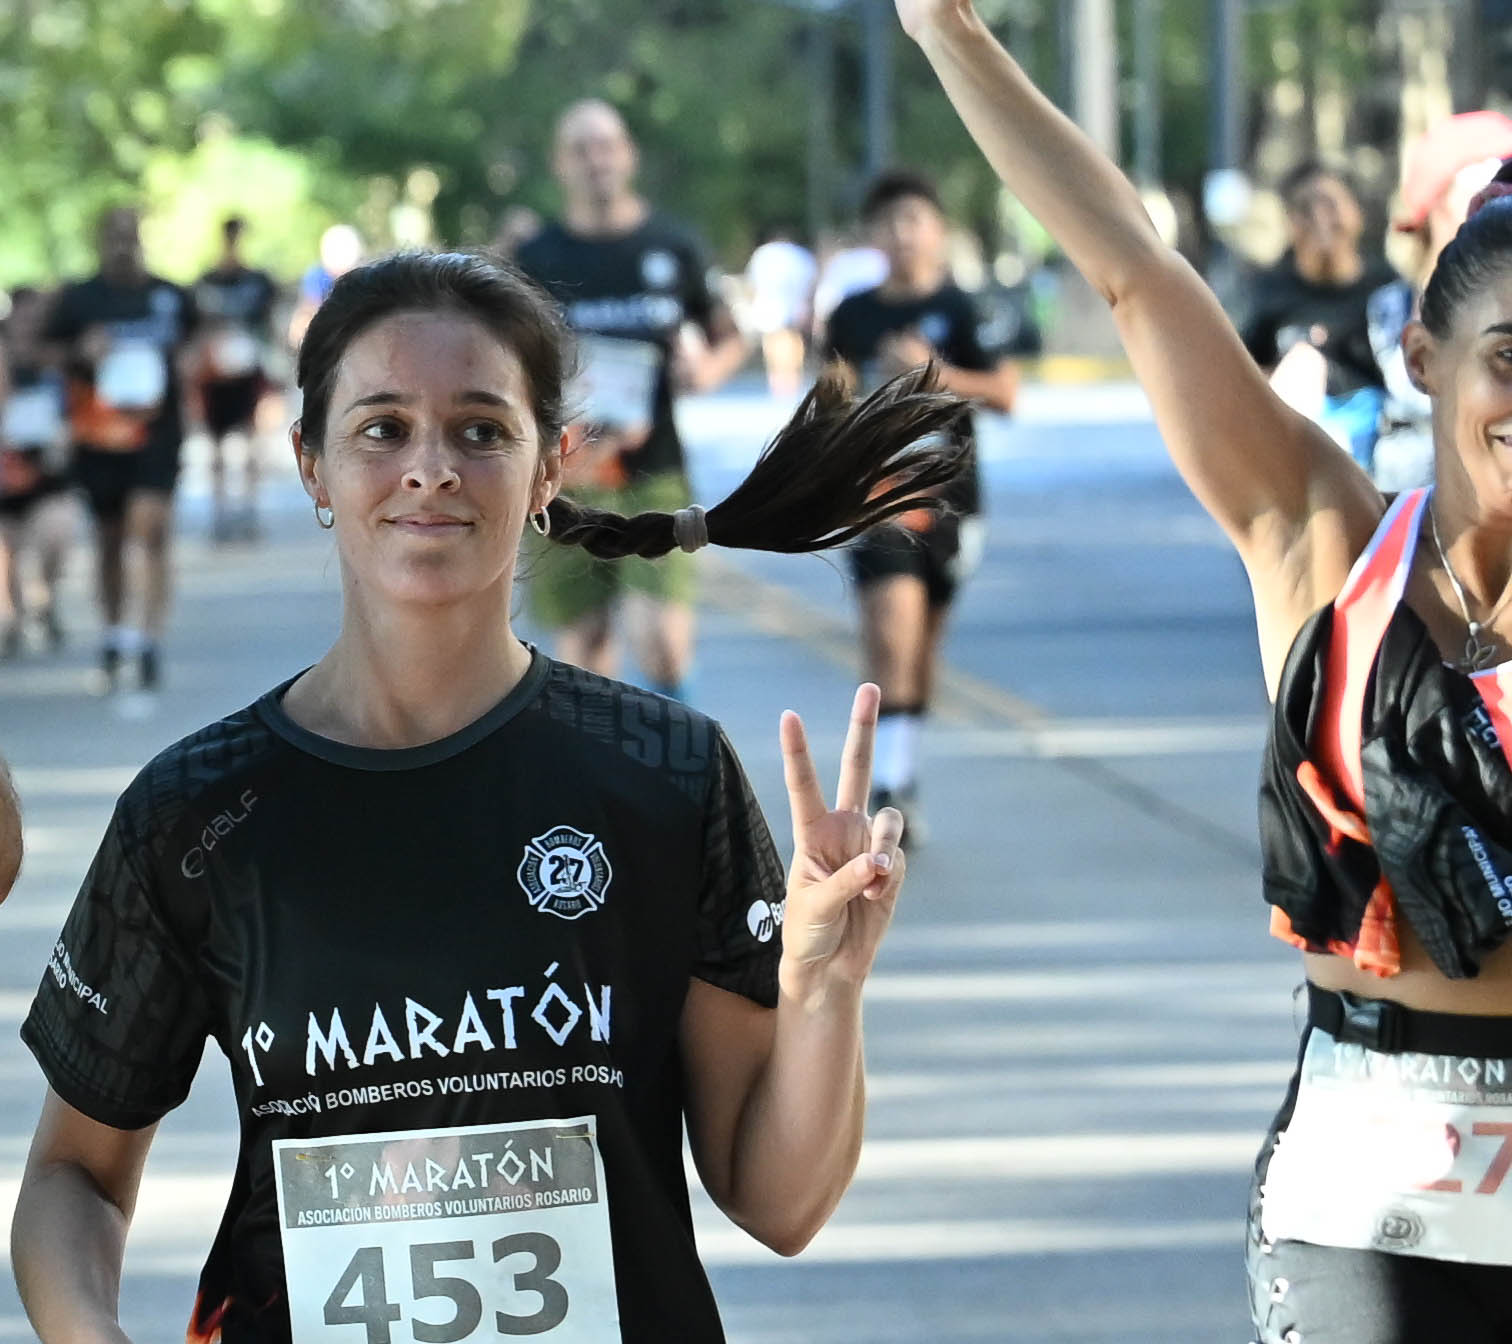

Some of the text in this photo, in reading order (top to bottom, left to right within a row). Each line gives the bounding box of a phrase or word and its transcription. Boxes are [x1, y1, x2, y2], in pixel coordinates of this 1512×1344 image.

[549, 855, 584, 886] 27
[306, 961, 612, 1077] MARATÓN
[326, 1079, 434, 1110] BOMBEROS
[437, 1068, 566, 1095] VOLUNTARIOS
[368, 1139, 554, 1197] MARATÓN
[297, 1187, 592, 1226] ASOCIACIÓN BOMBEROS VOLUNTARIOS ROSARIO
